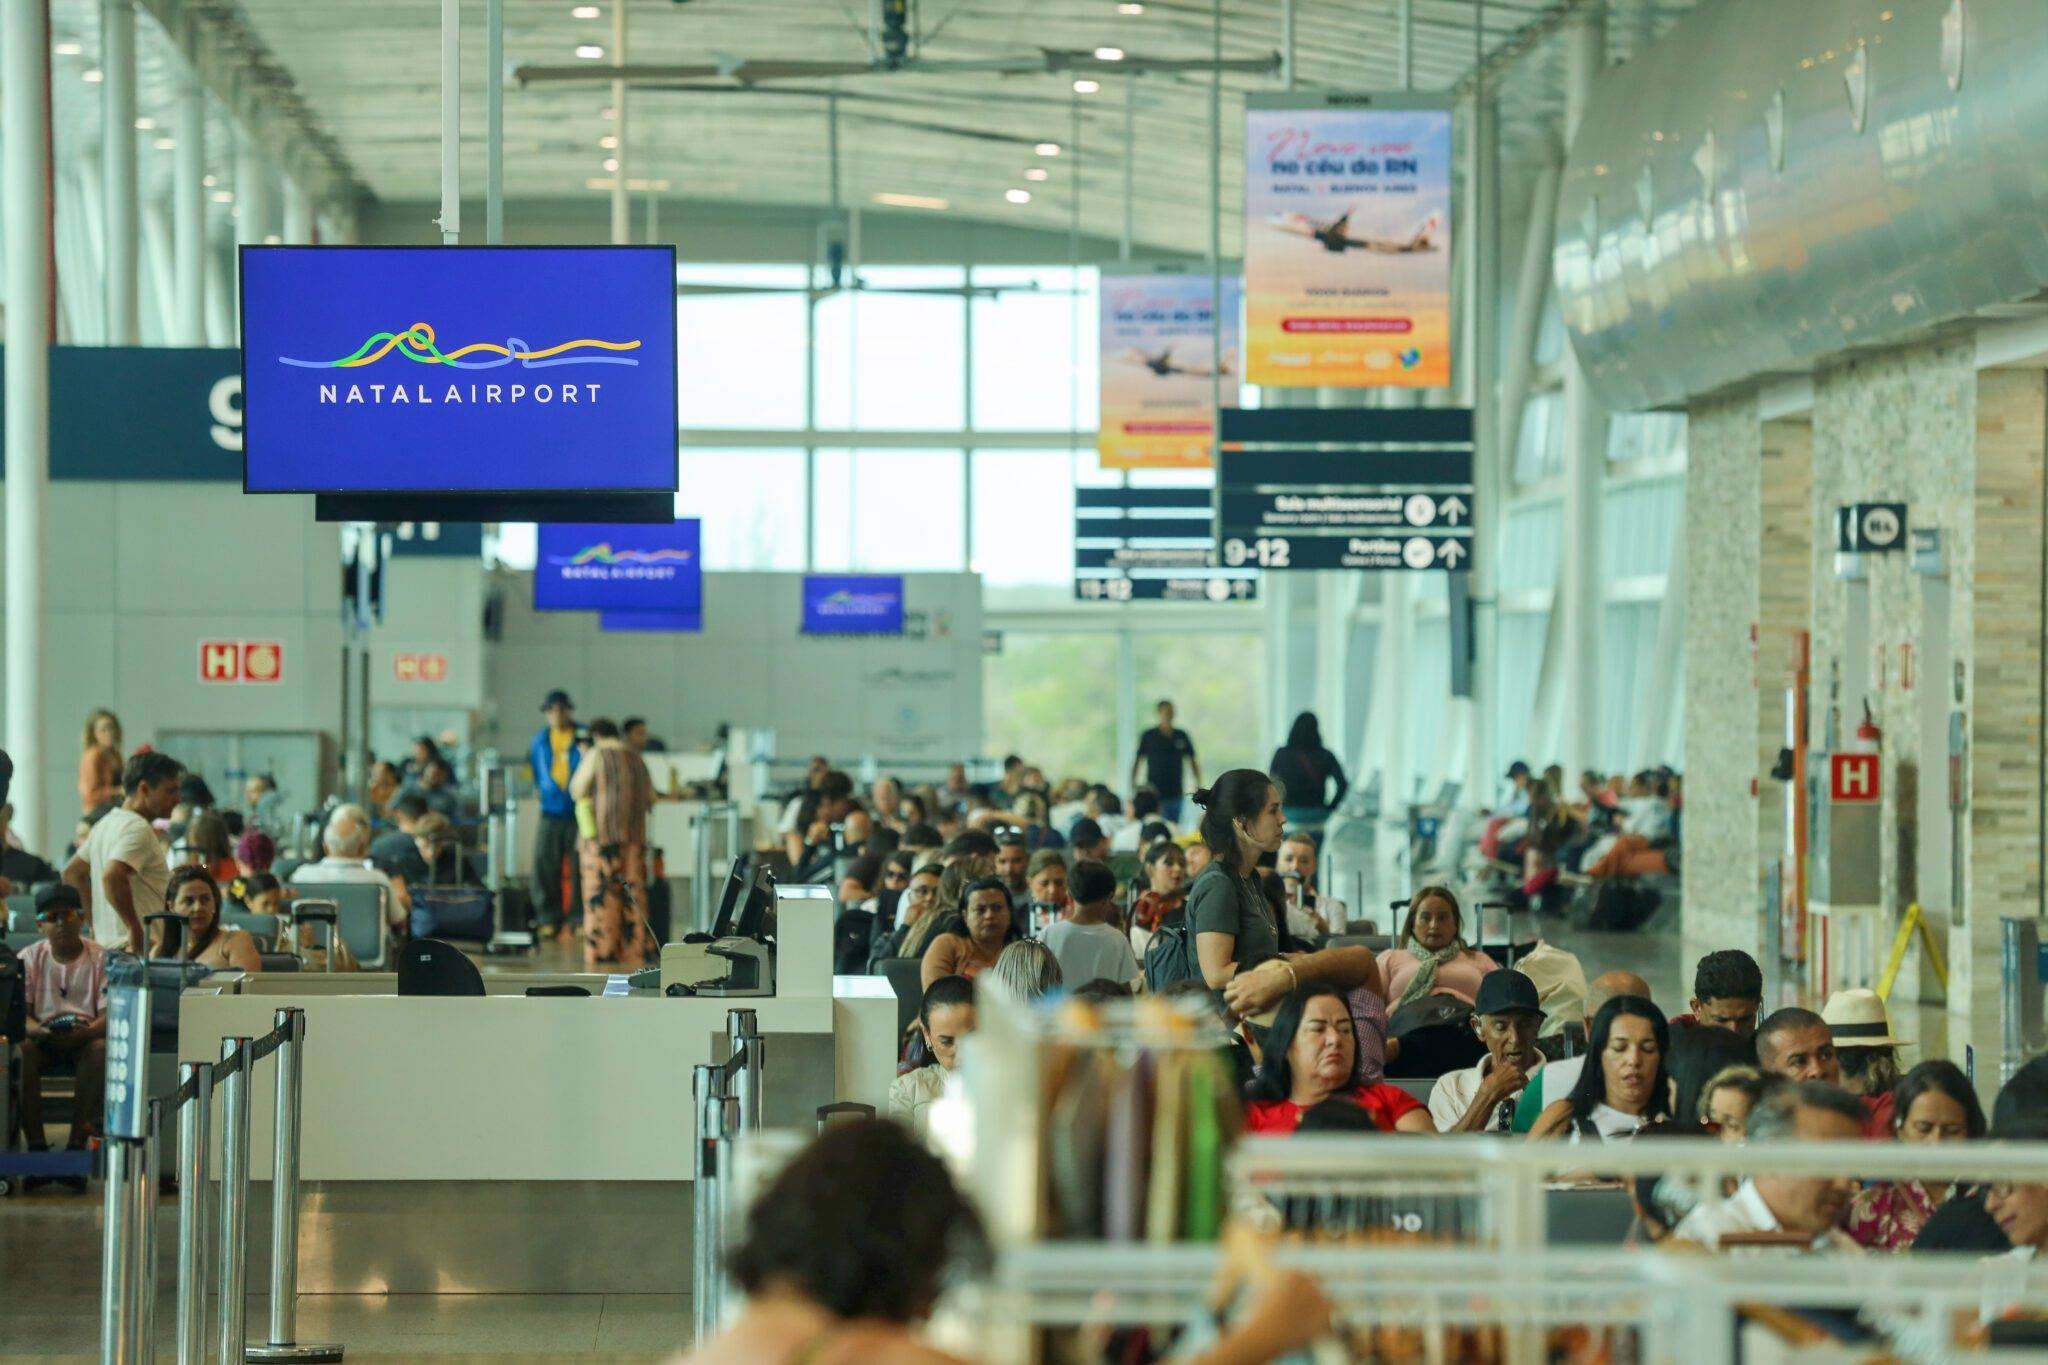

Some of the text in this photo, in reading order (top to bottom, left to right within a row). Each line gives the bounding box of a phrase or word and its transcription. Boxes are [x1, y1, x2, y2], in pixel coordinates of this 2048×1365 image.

[320, 384, 601, 403] NATAL AIRPORT
[1224, 538, 1290, 567] 9-12
[207, 647, 235, 678] H
[1842, 761, 1868, 794] H
